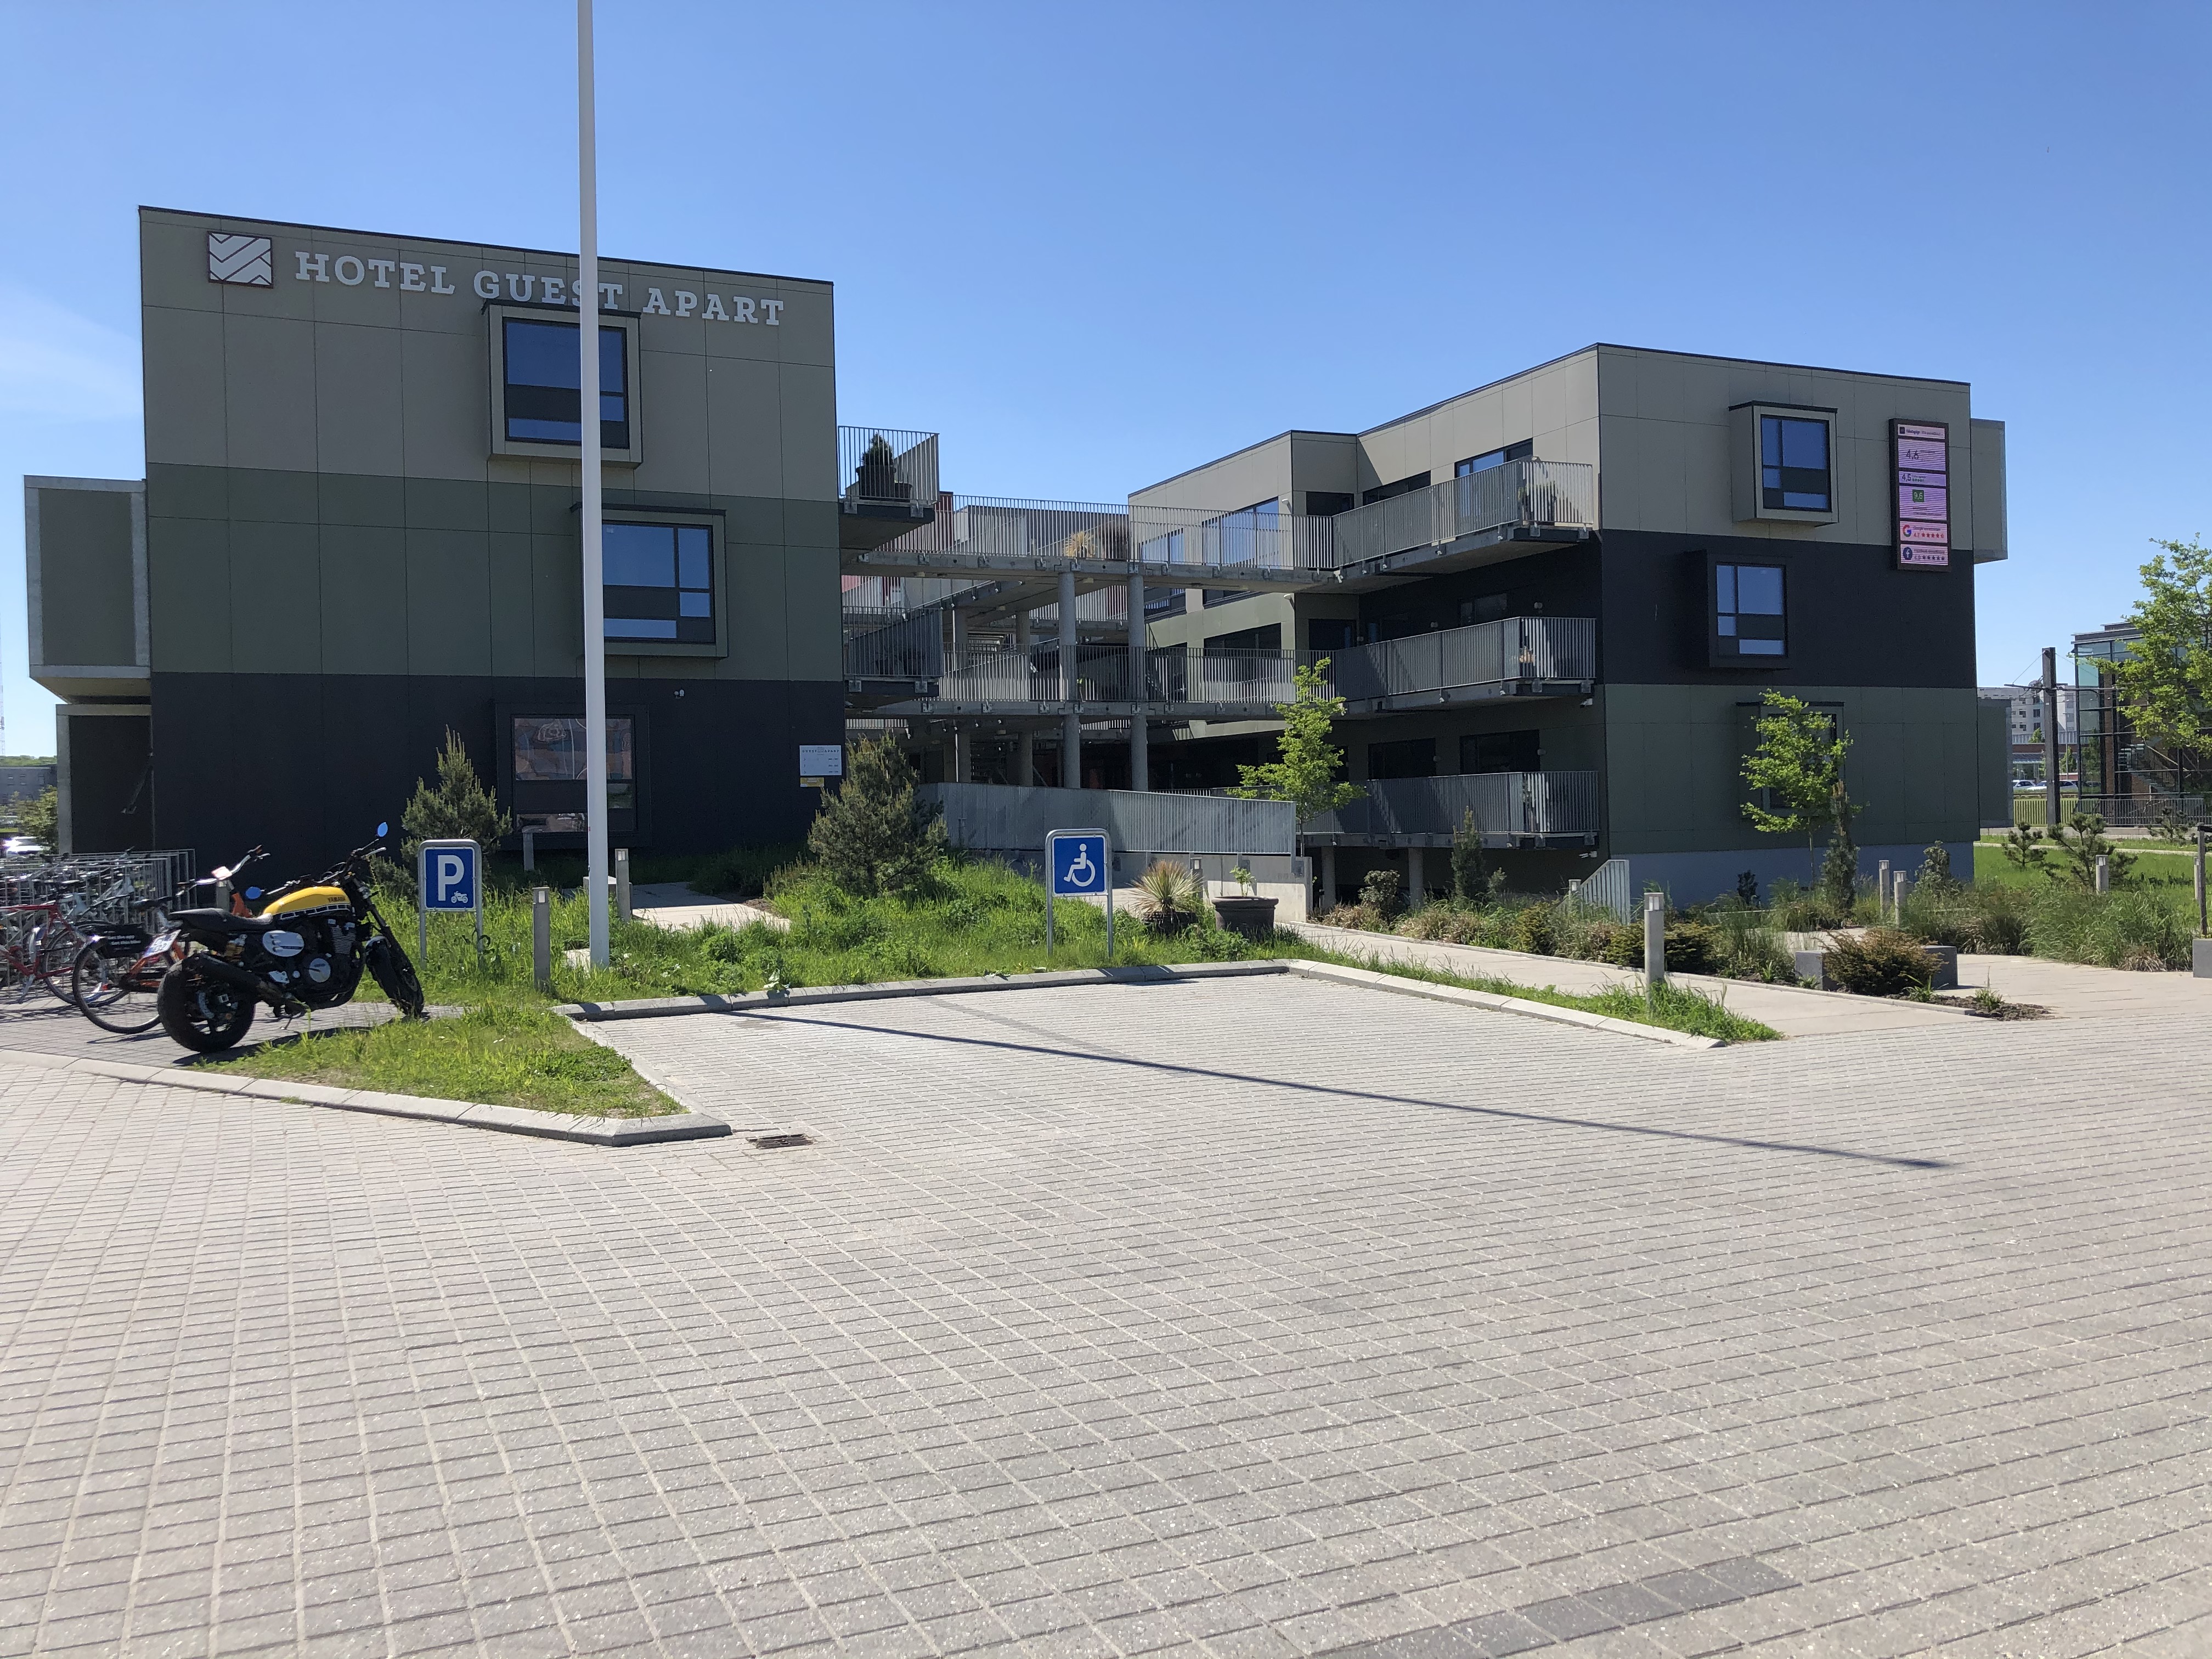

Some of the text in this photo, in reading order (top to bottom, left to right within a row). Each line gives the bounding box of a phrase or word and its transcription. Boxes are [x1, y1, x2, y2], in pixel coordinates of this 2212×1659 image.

[295, 251, 455, 295] HOTEL
[642, 287, 784, 325] APART
[1901, 473, 1911, 482] 4,5
[438, 855, 464, 901] P
